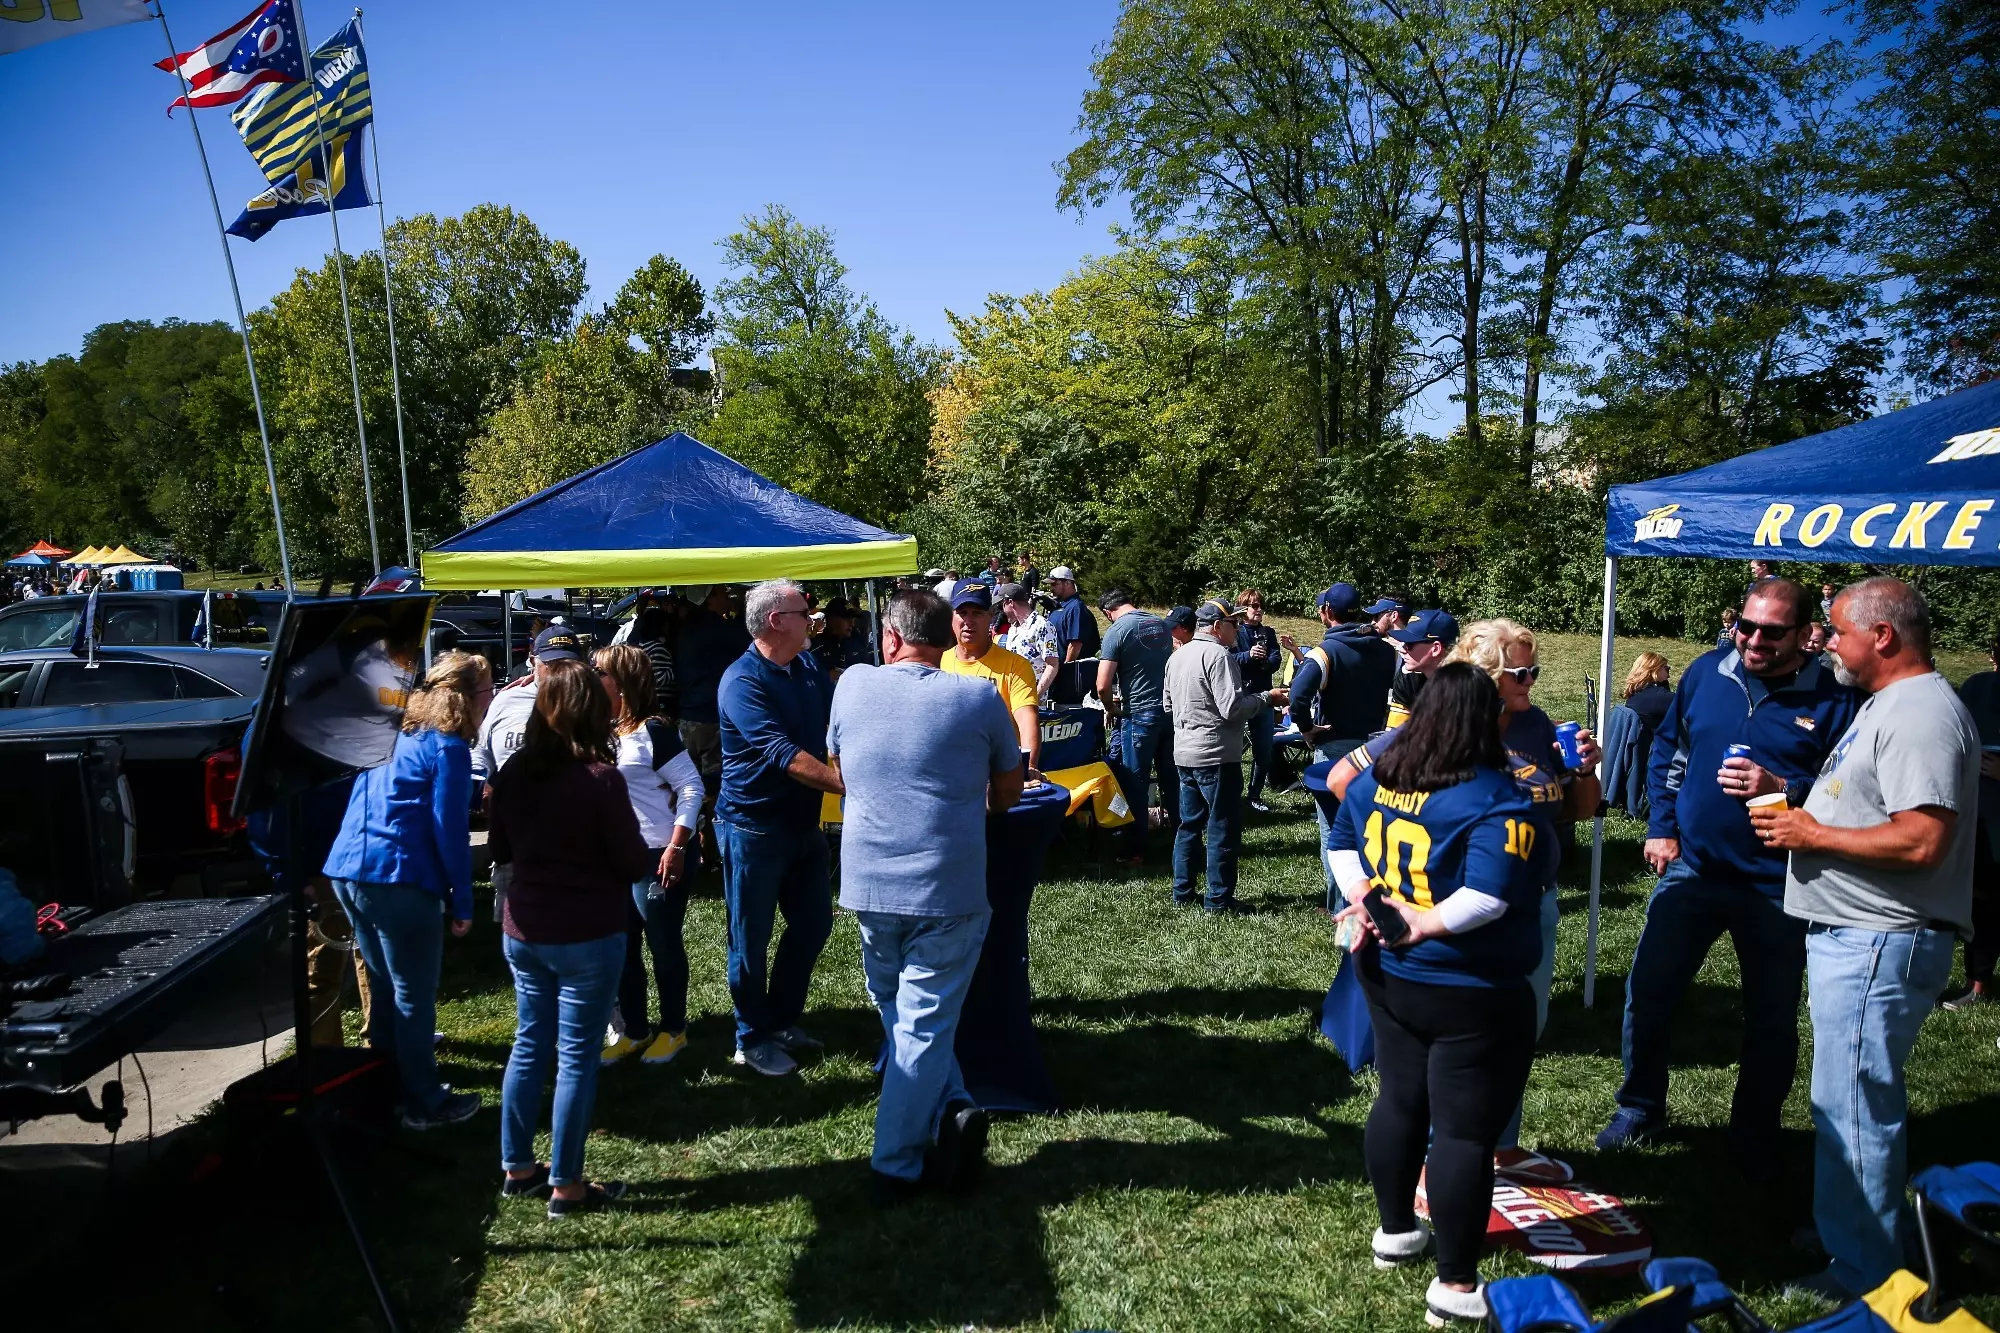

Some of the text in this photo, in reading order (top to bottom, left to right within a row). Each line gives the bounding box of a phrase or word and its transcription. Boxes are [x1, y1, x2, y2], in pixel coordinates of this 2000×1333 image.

[1634, 518, 1683, 543] TOLEDO
[1753, 499, 2000, 550] ROCKE
[1373, 784, 1430, 816] BRADY
[1363, 809, 1434, 913] 10
[1504, 818, 1536, 861] 10
